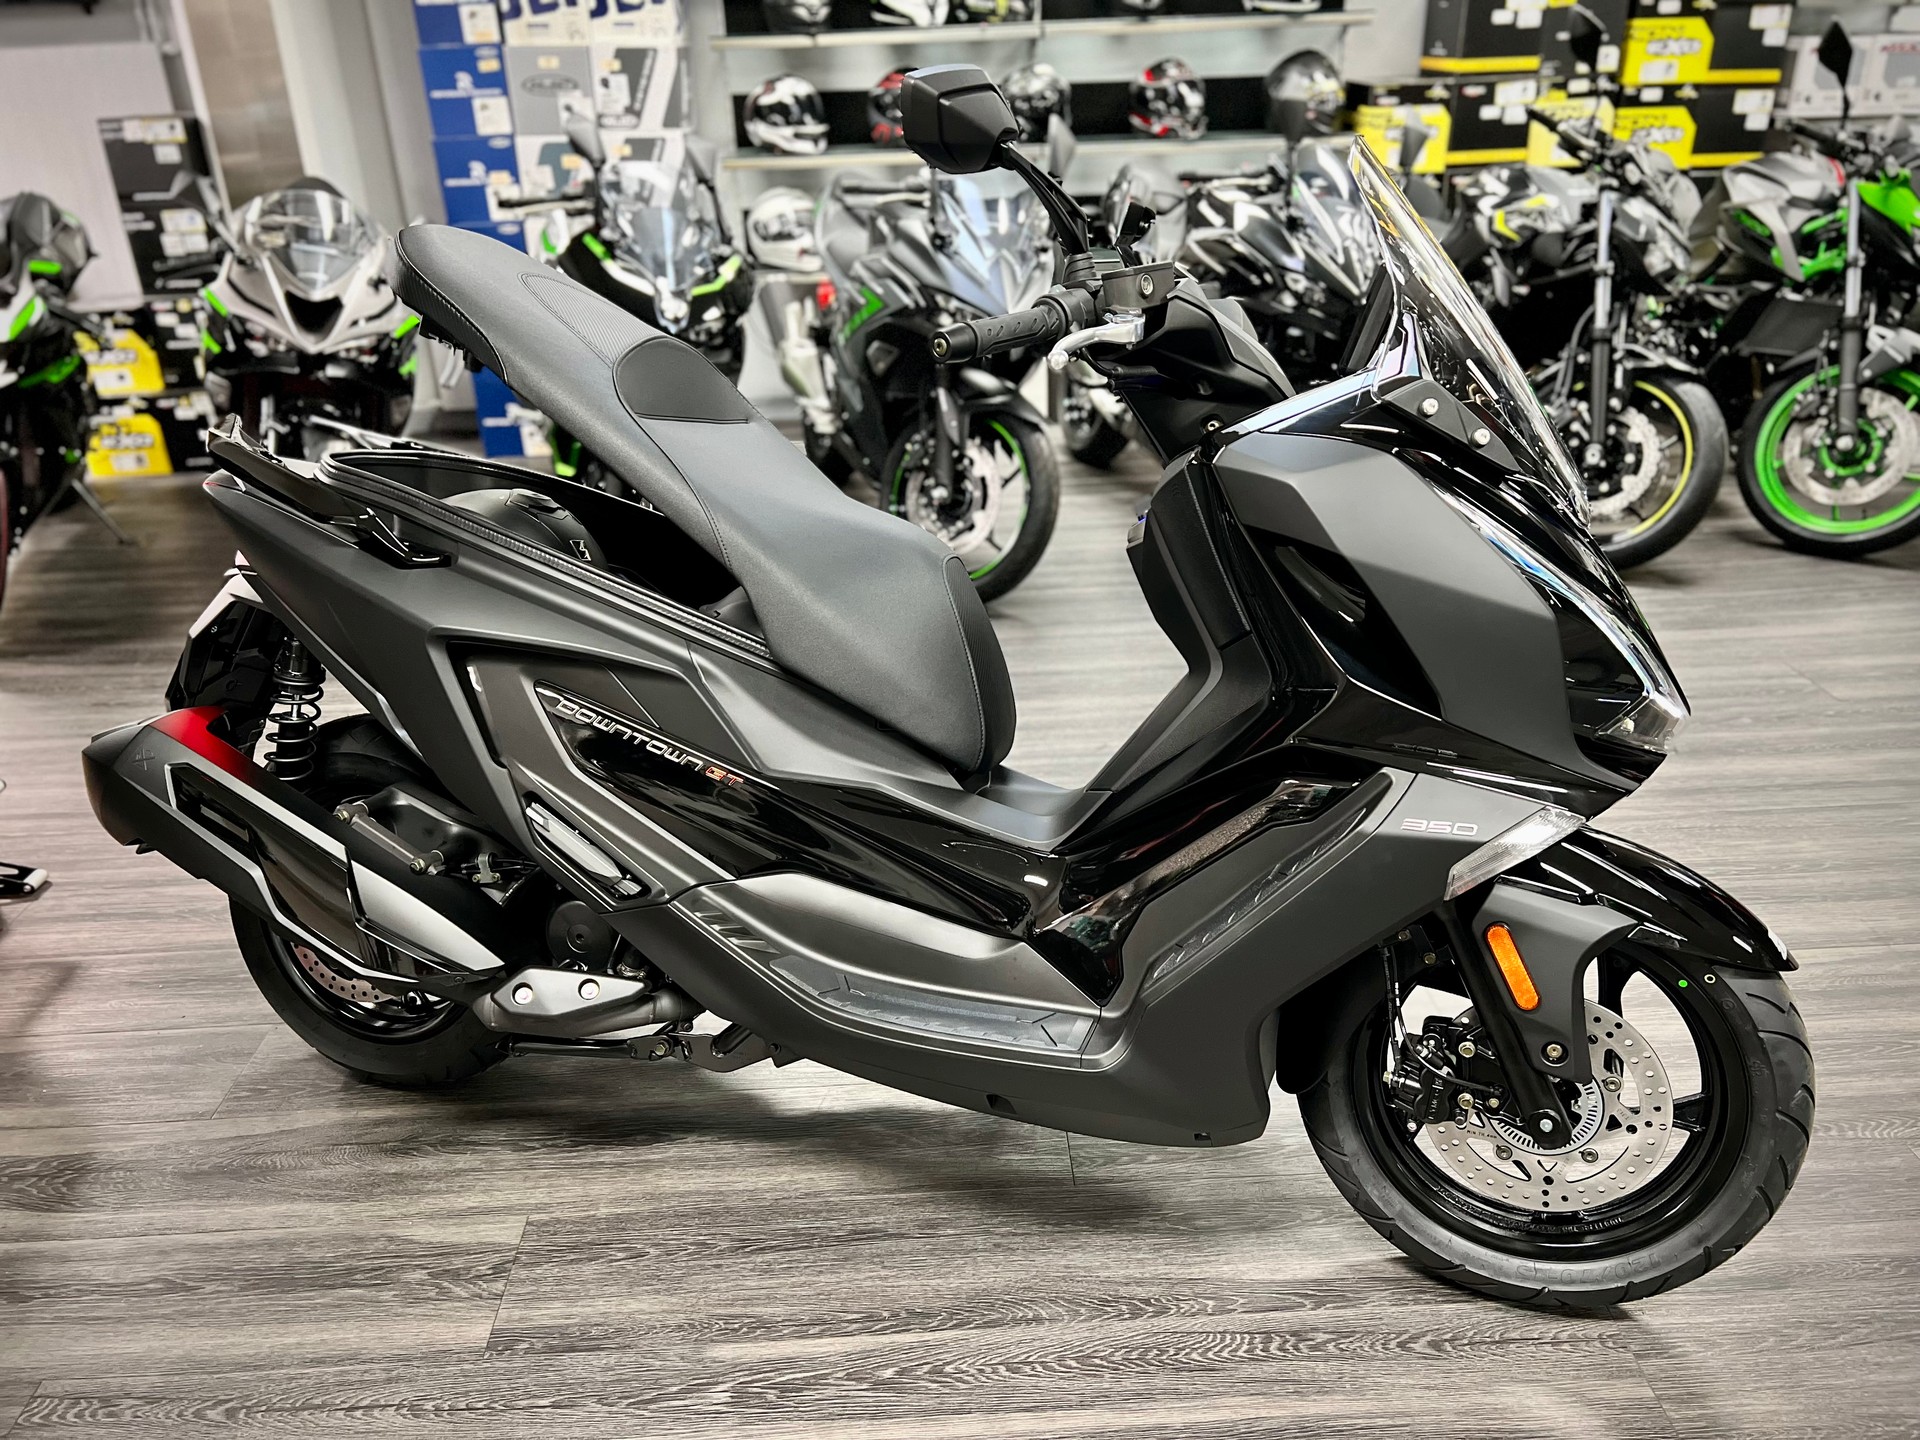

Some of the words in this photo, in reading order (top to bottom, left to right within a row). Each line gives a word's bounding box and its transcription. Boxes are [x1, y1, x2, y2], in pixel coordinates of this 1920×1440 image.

[555, 699, 703, 772] DOWNTOWN
[704, 765, 744, 786] GT
[1400, 818, 1479, 836] 350
[1515, 1252, 1662, 1285] 120/70-15
